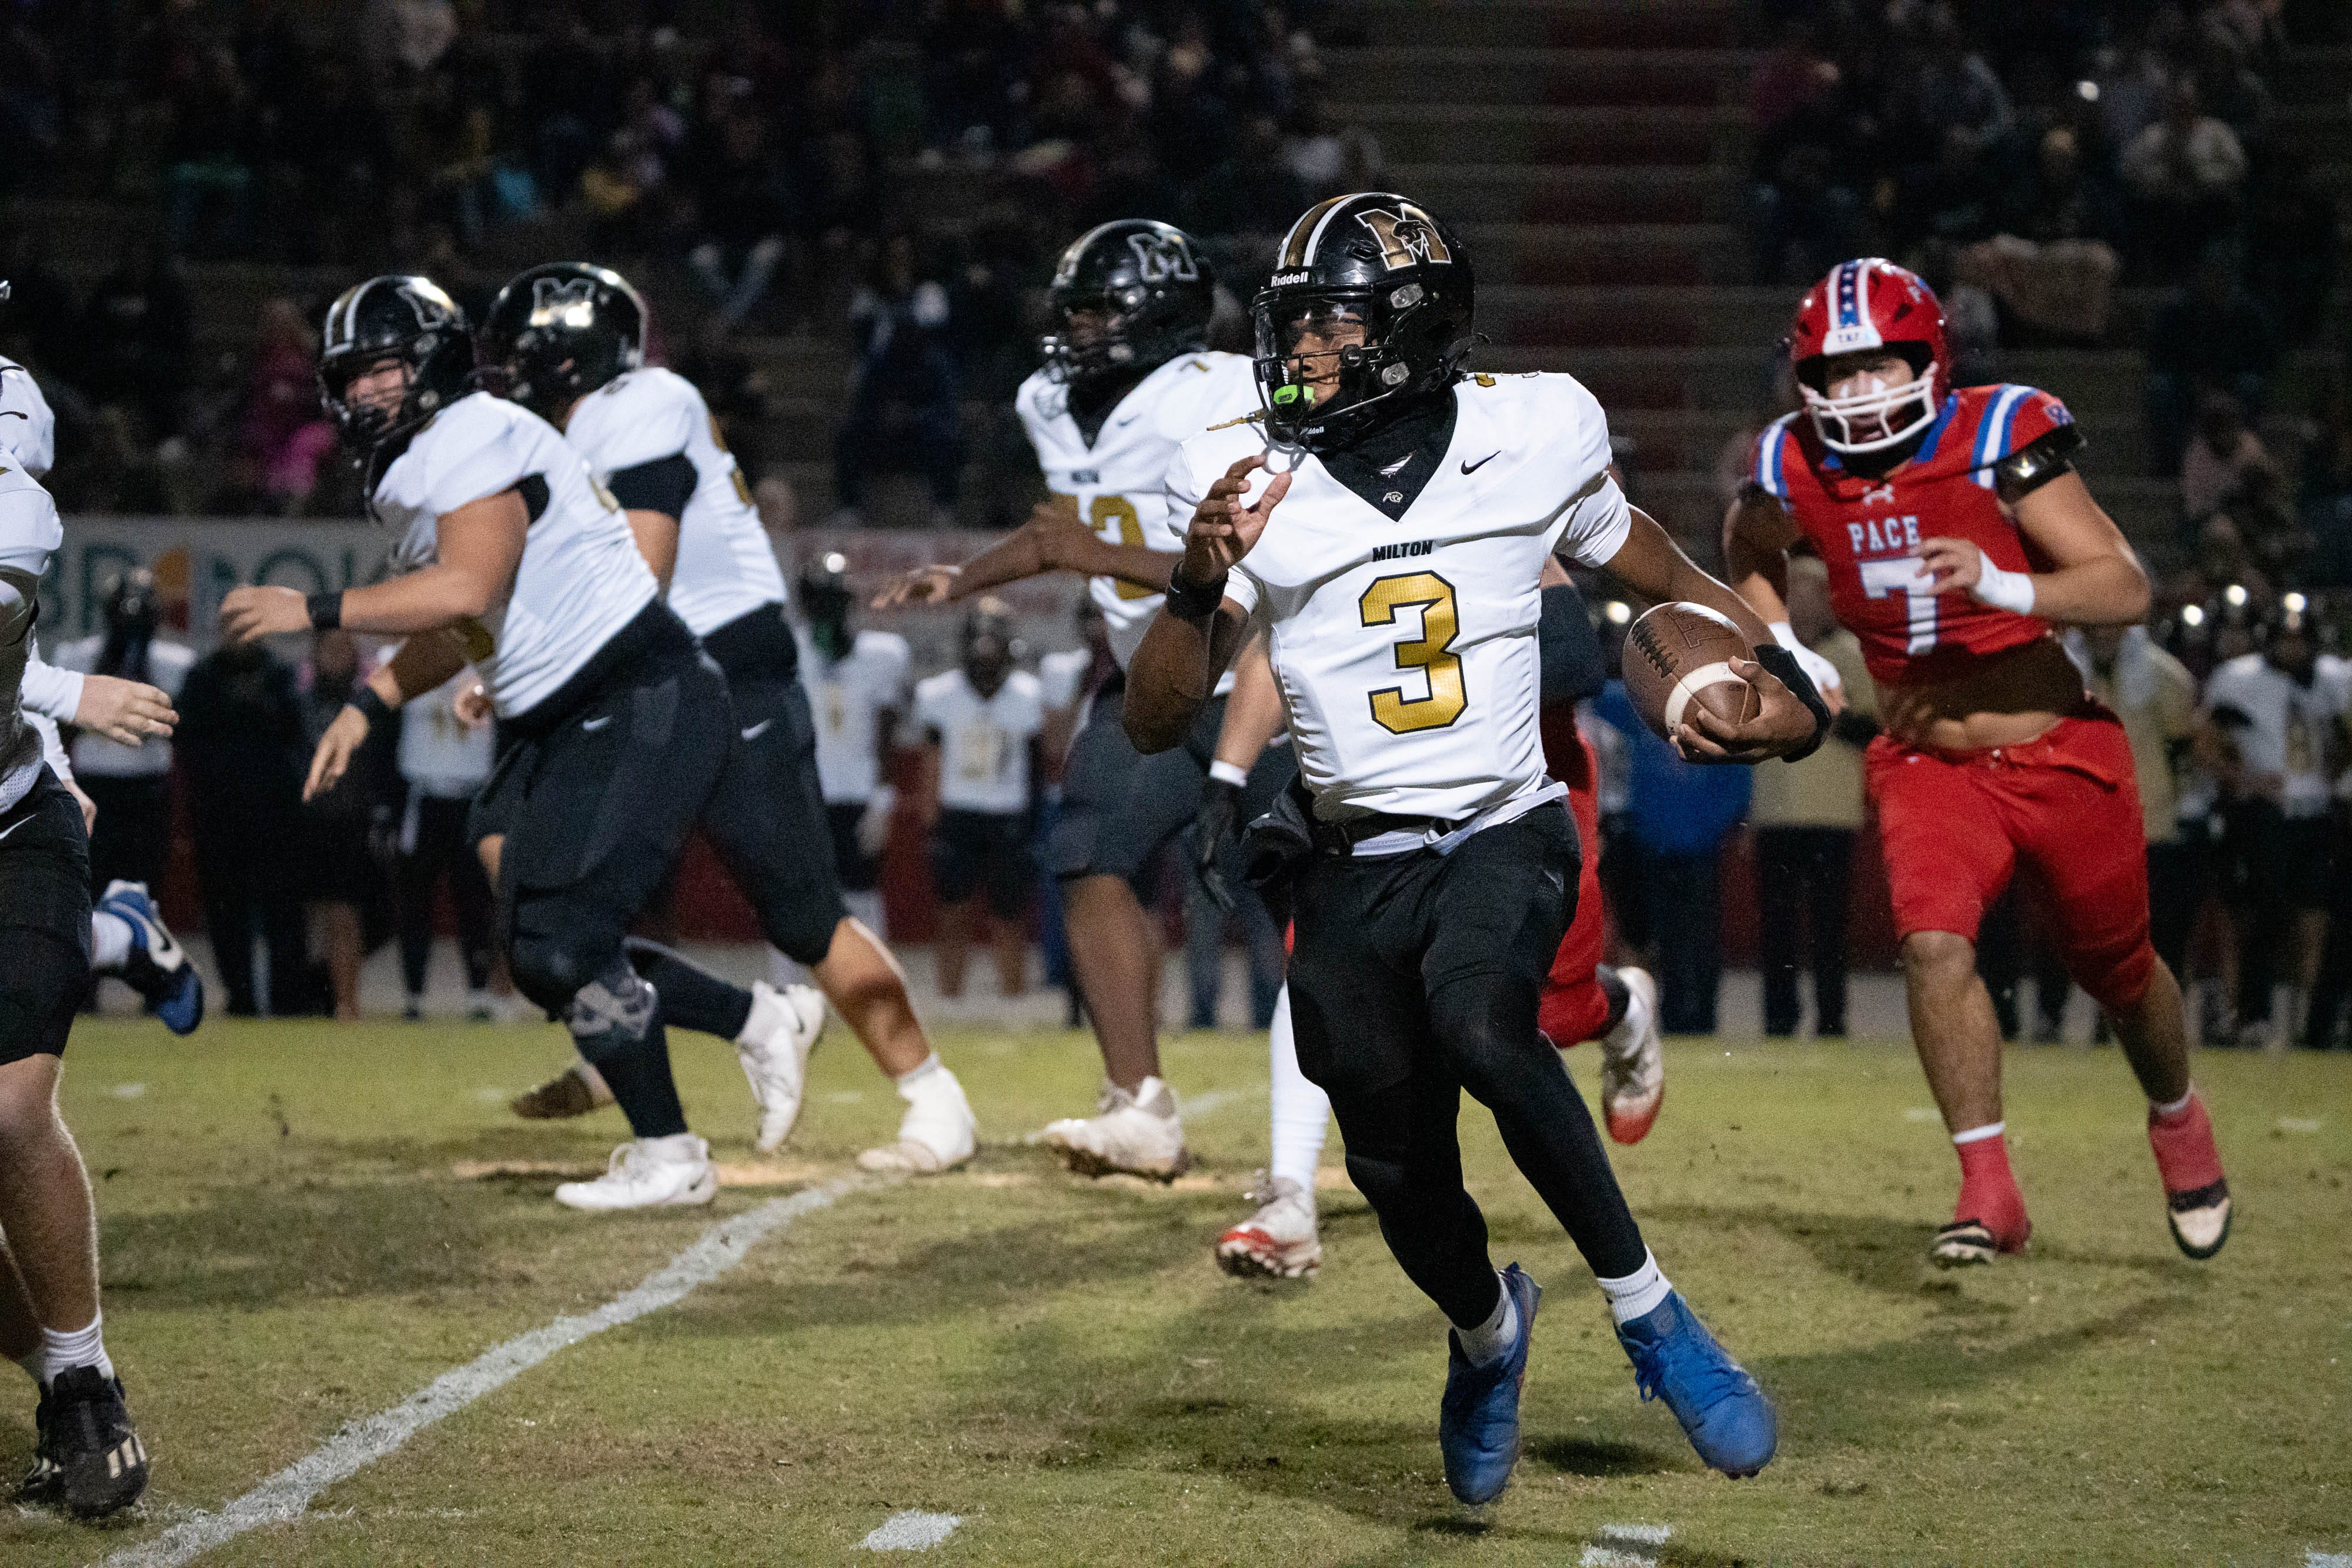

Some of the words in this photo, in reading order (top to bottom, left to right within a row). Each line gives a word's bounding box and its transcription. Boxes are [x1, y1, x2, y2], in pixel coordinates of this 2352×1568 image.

[1354, 202, 1452, 270] M
[1271, 271, 1308, 287] Riddell
[1307, 426, 1324, 435] ddell
[1372, 540, 1433, 561] MILTON
[1847, 515, 1920, 553] PACE
[1858, 559, 1938, 656] 7
[1358, 569, 1469, 735] 3
